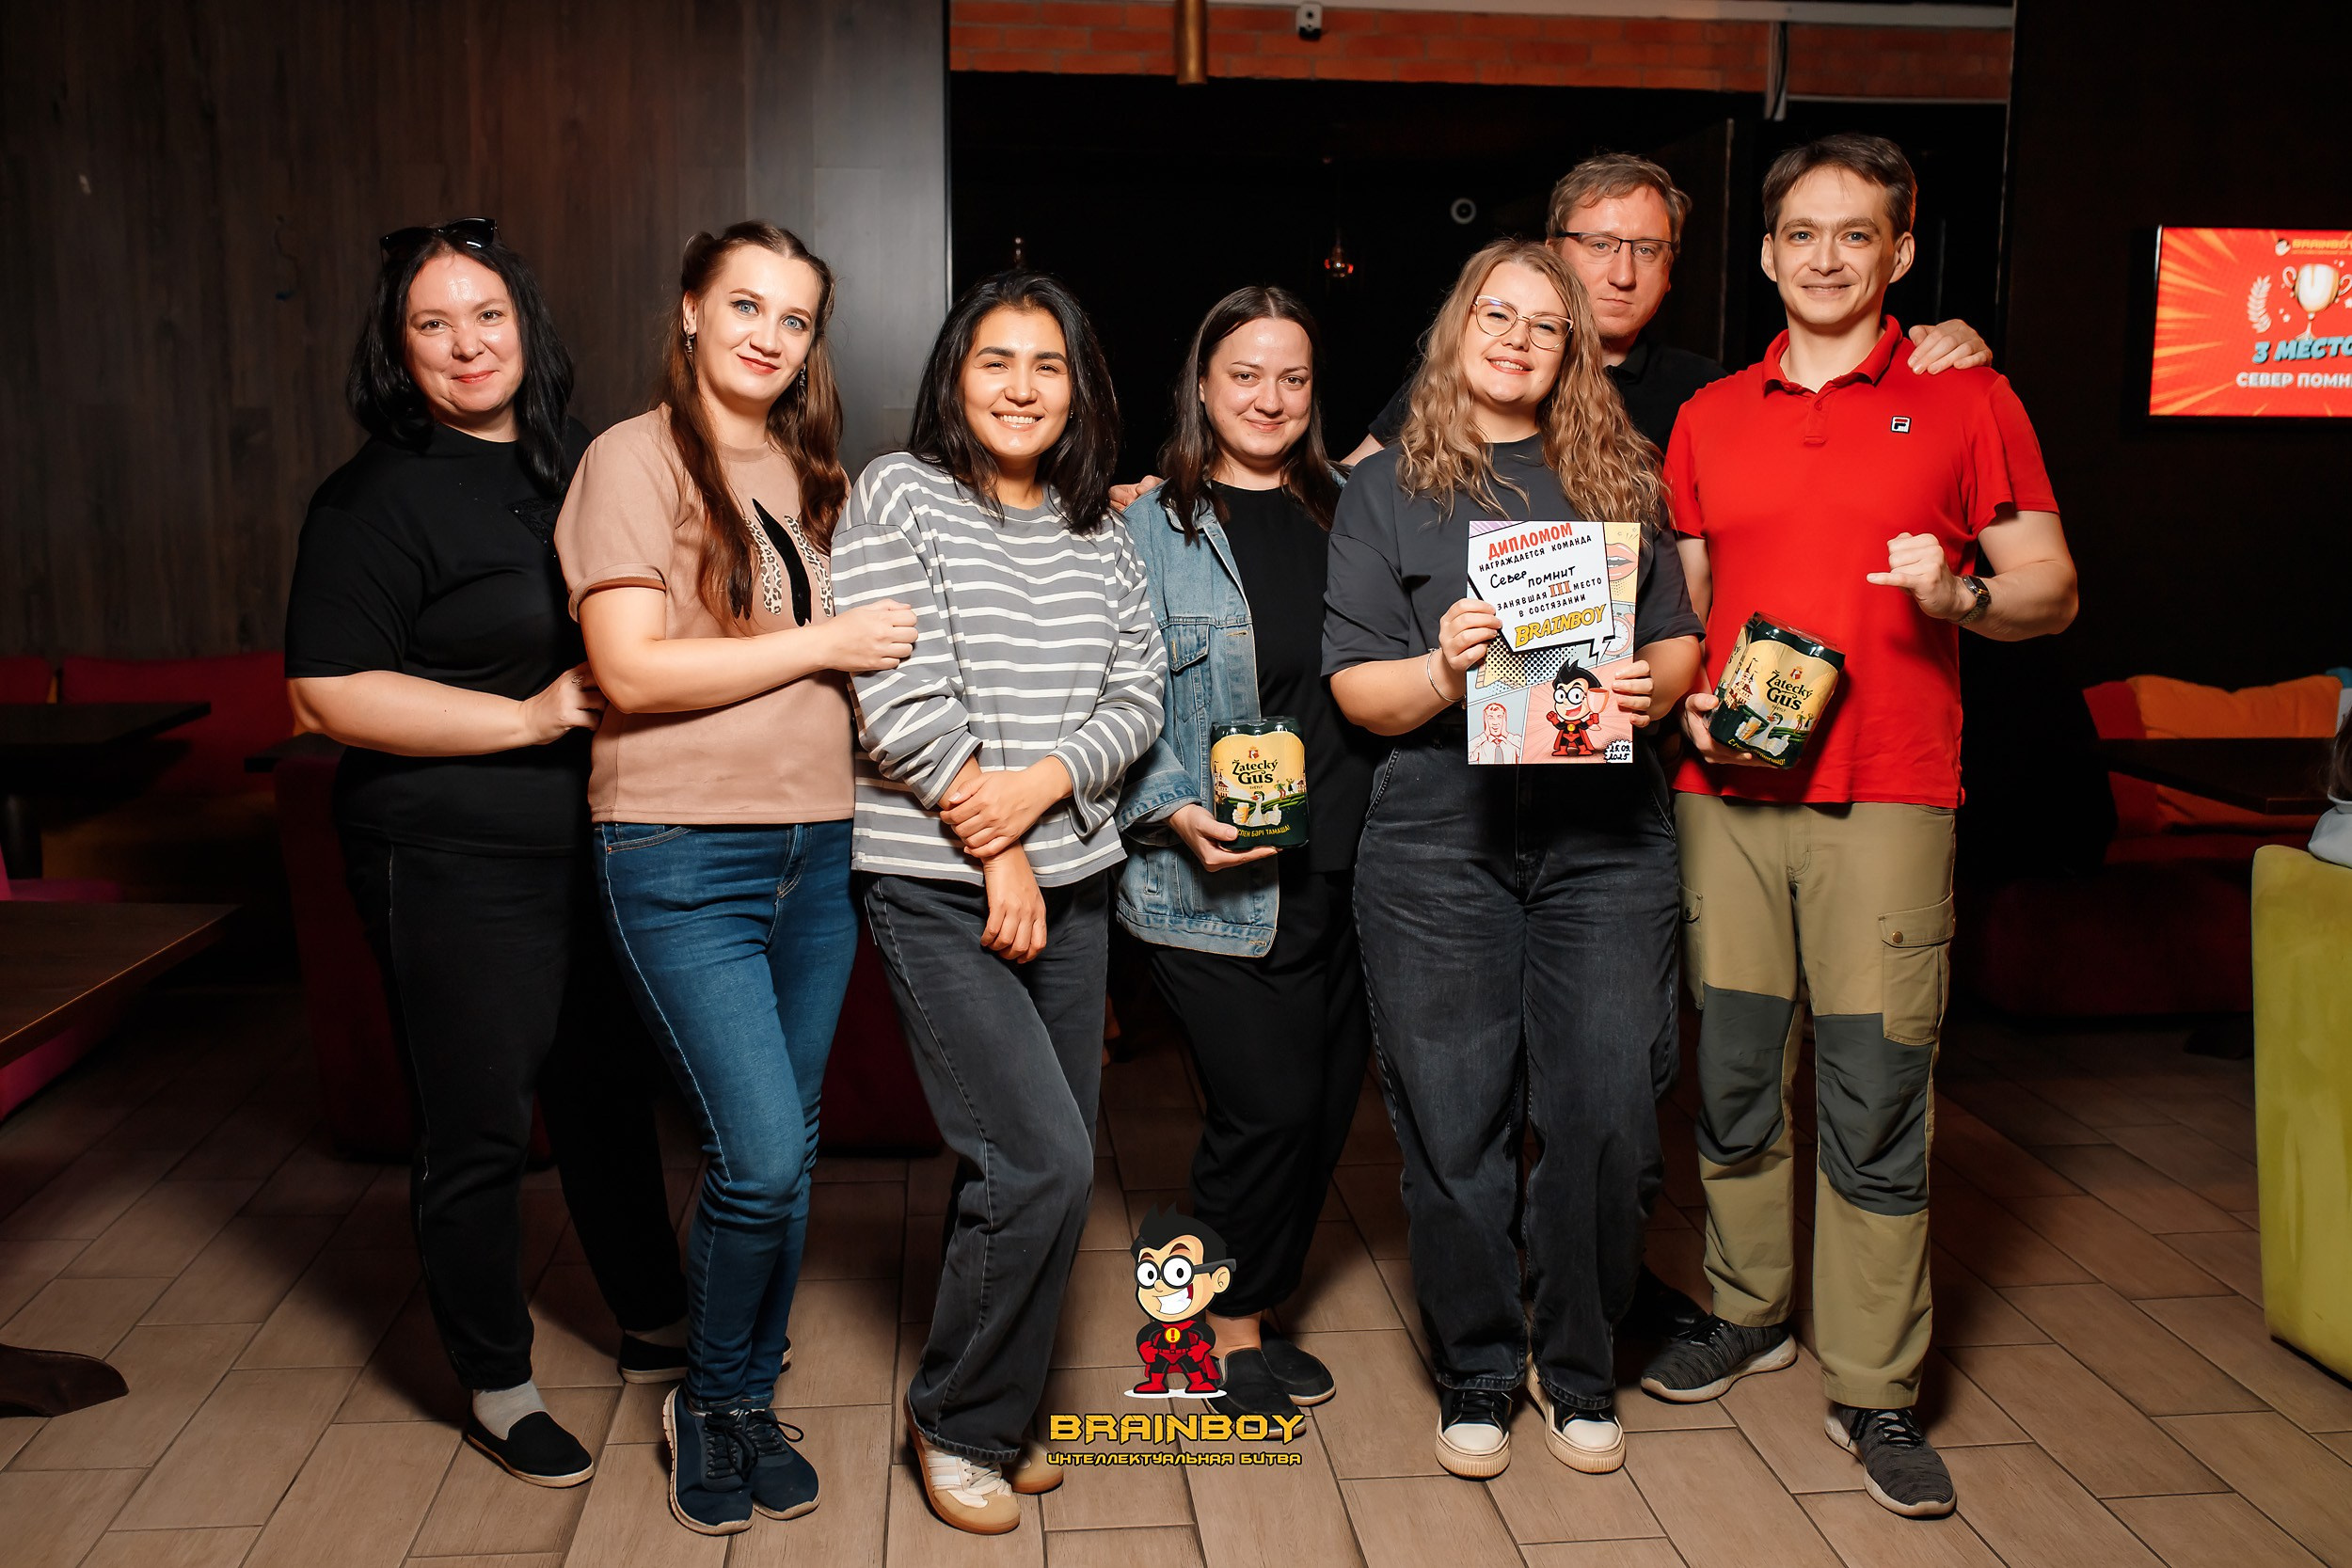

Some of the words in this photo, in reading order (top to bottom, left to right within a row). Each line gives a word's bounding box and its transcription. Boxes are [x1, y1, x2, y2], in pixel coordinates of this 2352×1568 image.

[2292, 238, 2352, 249] BRAINBO
[2252, 341, 2270, 364] 3
[2236, 372, 2294, 388] СЕВЕР
[2296, 372, 2352, 388] ПОМН
[1479, 548, 1546, 573] НАГРАЖДАЕТСЯ
[1551, 534, 1592, 551] КОМАНДА
[1488, 523, 1573, 561] ДИПЛОМОМ
[1490, 570, 1527, 589] Север
[1497, 592, 1548, 611] ЗАНЯВШАЯ
[1549, 580, 1572, 598] III
[1573, 577, 1602, 591] МЕСТО
[1518, 610, 1524, 618] В
[1529, 594, 1586, 615] СОСТЯЗАНИИ
[1515, 604, 1607, 648] BRAINBOY
[1766, 670, 1814, 701] Žatecký
[1232, 758, 1279, 776] Žatecký
